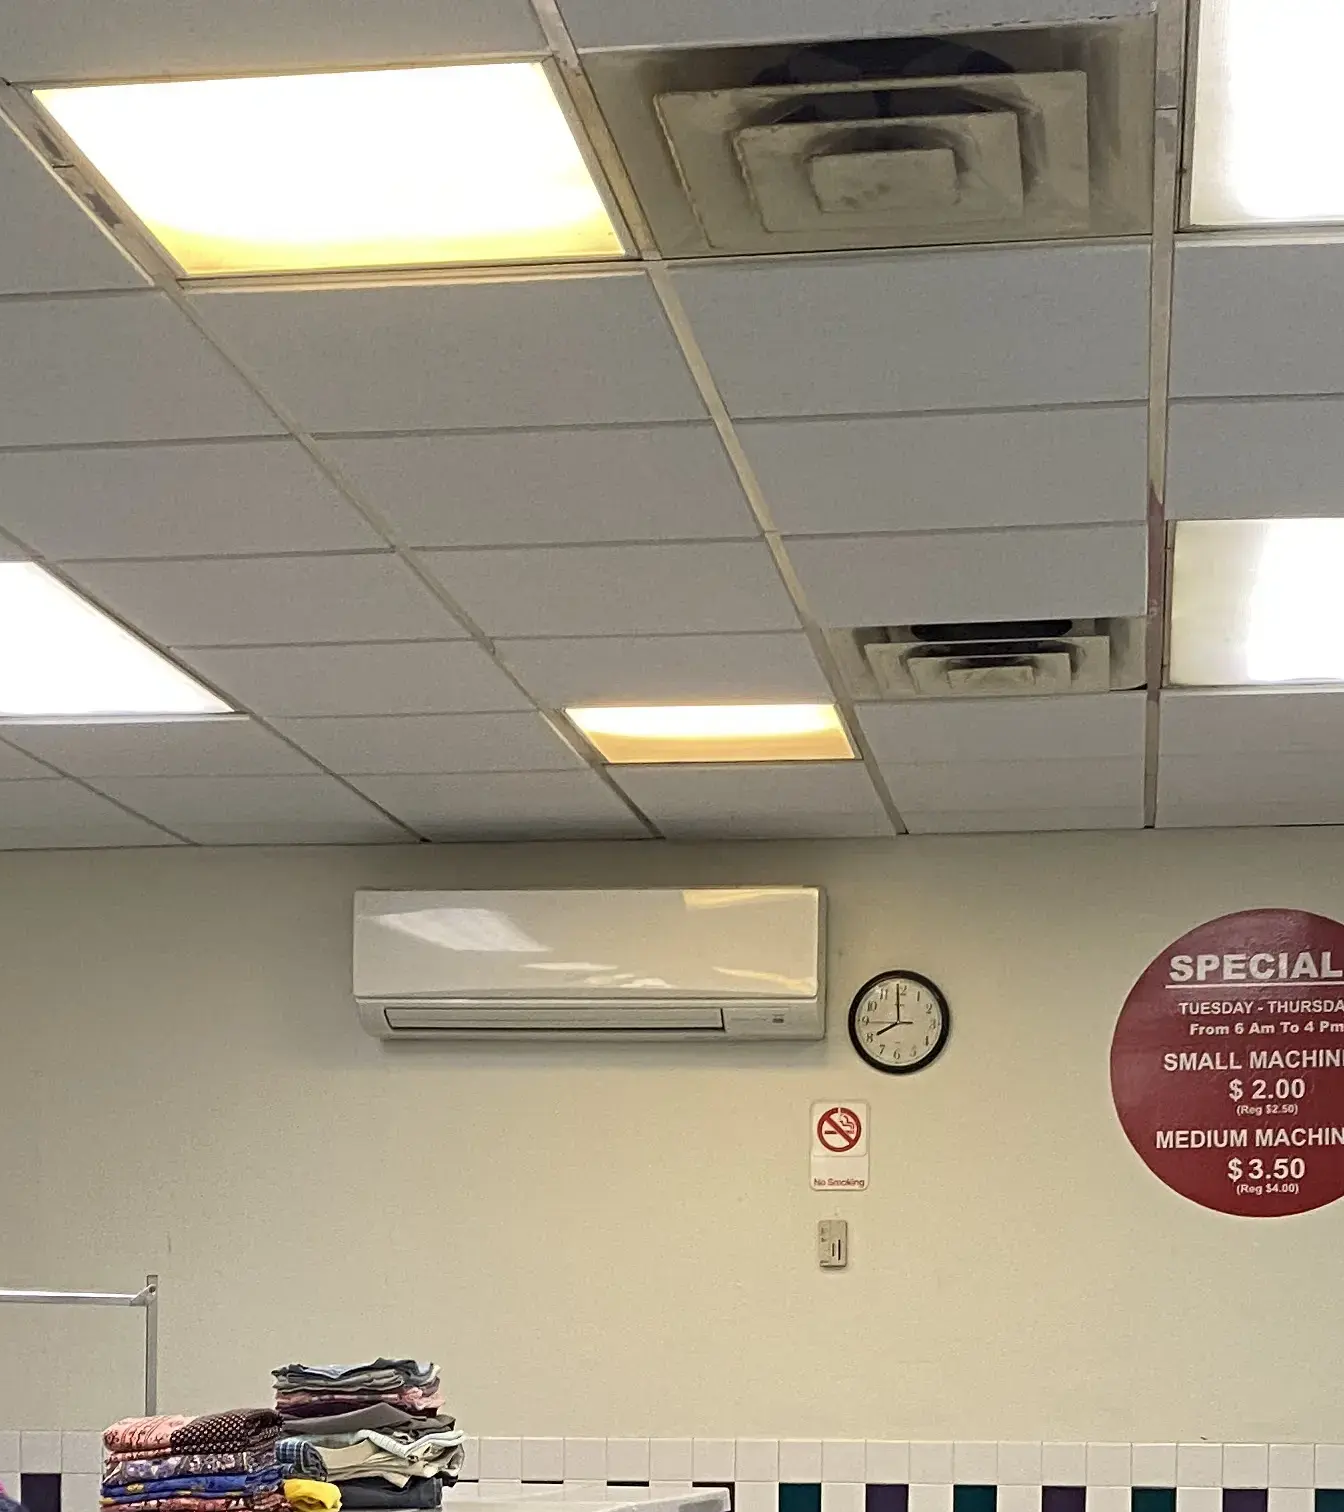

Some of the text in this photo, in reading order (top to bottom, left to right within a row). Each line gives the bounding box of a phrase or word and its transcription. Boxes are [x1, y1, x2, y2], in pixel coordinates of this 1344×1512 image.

[1178, 1001, 1254, 1015] TUESDAY
[1189, 1020, 1344, 1036] From 6 Am To 4 Pm
[1164, 1052, 1243, 1072] SMALL
[1229, 1078, 1306, 1102] $ 2.00
[1156, 1129, 1248, 1149] MEDIUM
[1227, 1157, 1306, 1182] $ 3.50
